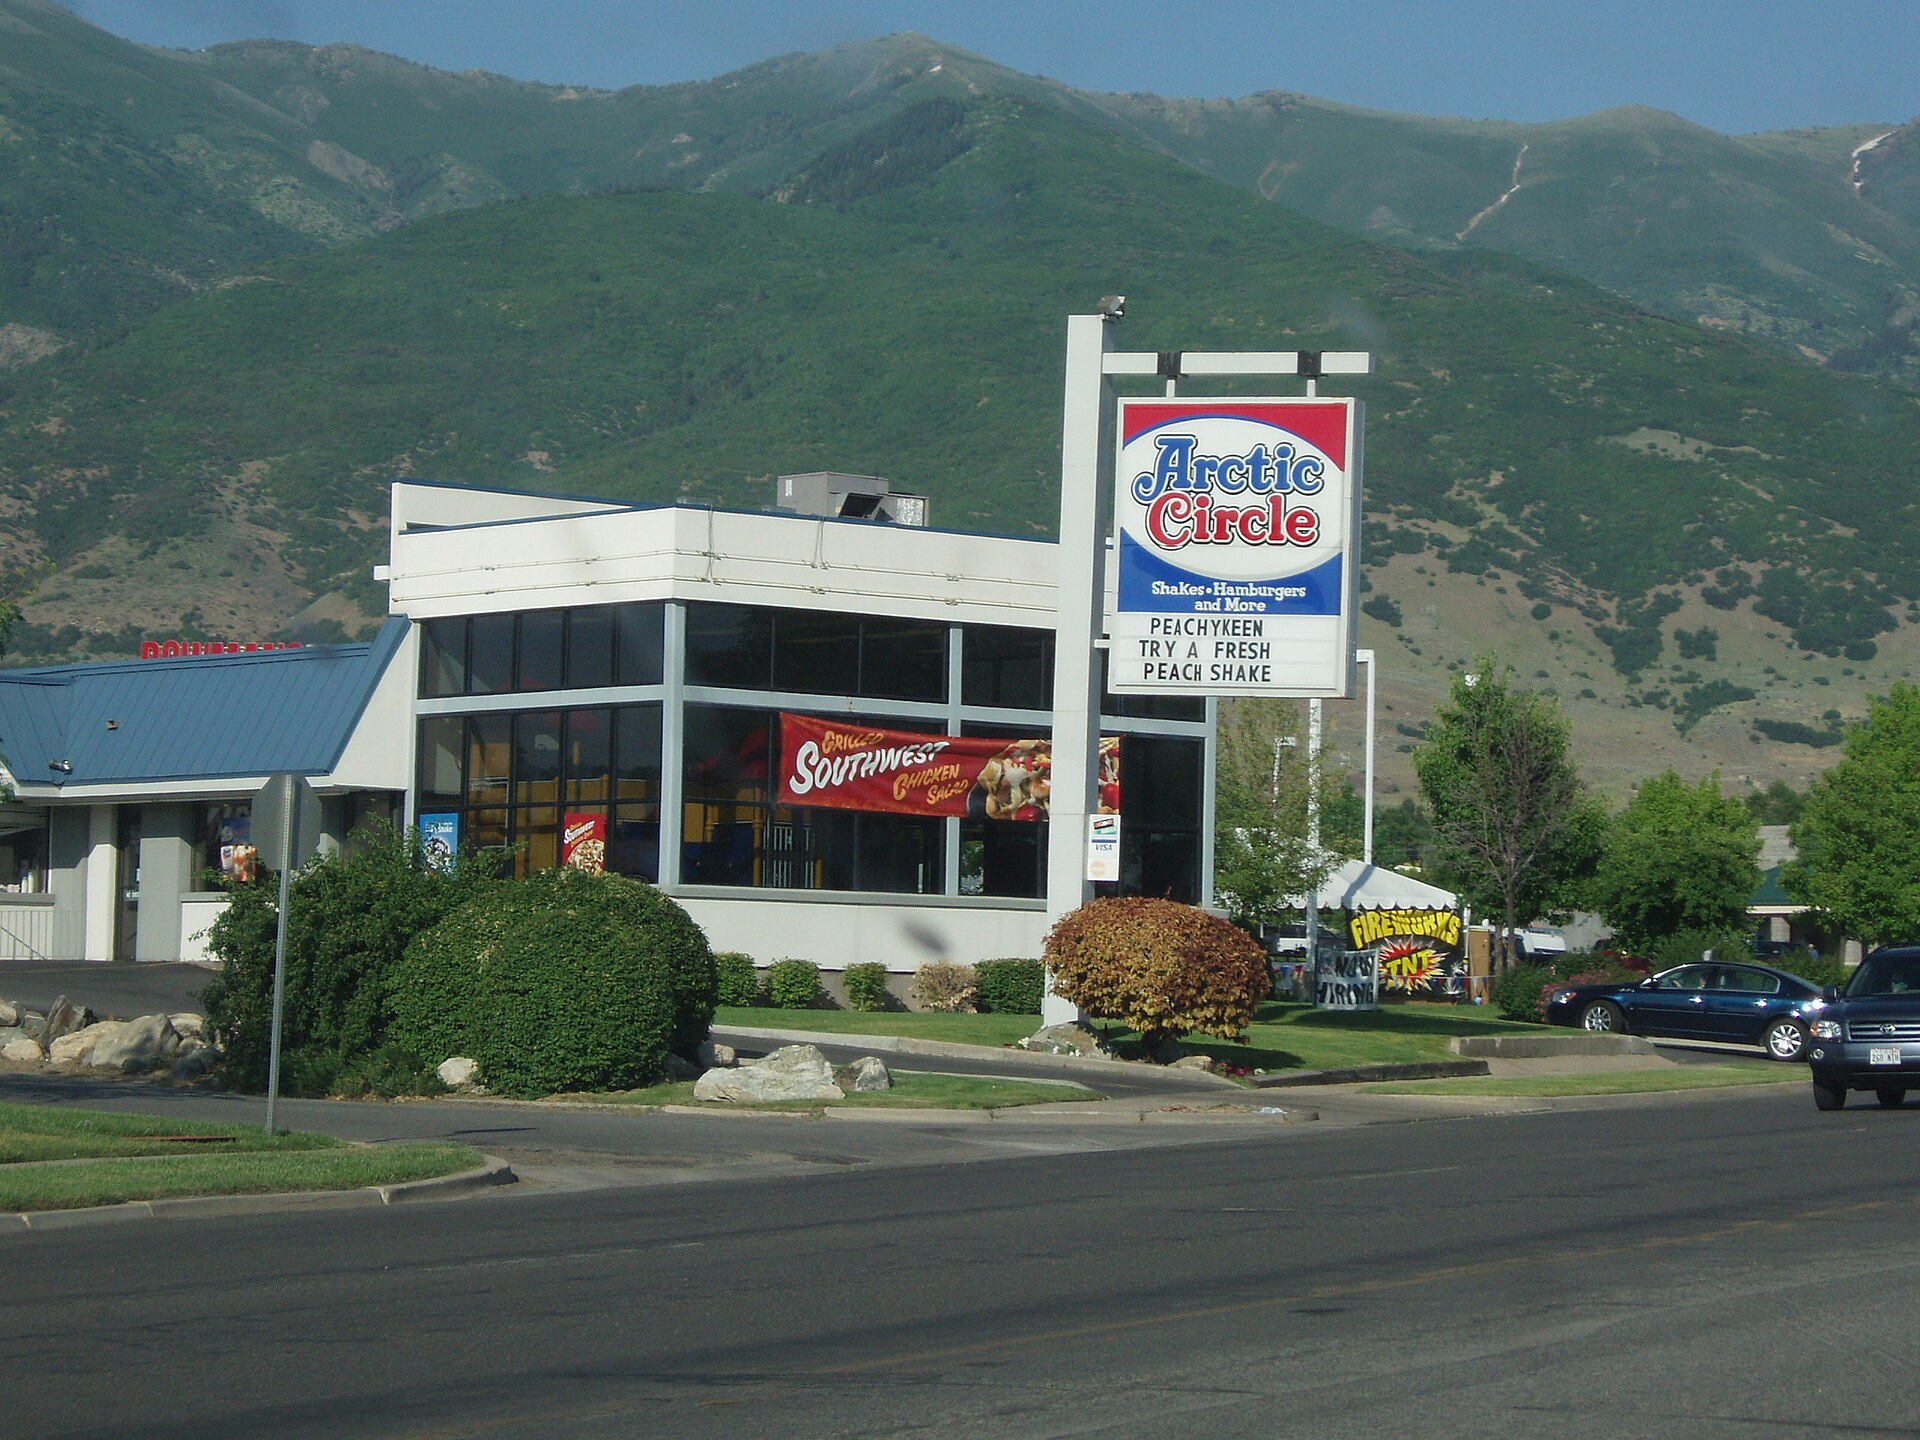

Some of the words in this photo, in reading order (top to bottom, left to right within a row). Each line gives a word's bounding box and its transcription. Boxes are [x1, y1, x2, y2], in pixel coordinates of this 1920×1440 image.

[1132, 434, 1324, 503] Arctic
[1146, 490, 1319, 549] Circle
[1212, 582, 1306, 601] Hamburgers
[1194, 598, 1221, 612] and
[1224, 598, 1266, 612] More
[1150, 617, 1263, 637] PEACHYKEEN
[1139, 640, 1177, 658] TRY
[1186, 641, 1199, 658] A
[1214, 641, 1271, 660] FRESH
[1143, 662, 1202, 681] PEACH
[1210, 663, 1272, 682] SHAKE
[821, 730, 885, 755] GRILLED
[788, 740, 951, 795] SOUTHWEST
[892, 763, 961, 801] CHICKEN
[926, 779, 969, 805] SALAD
[1095, 843, 1113, 851] VISA
[1386, 948, 1432, 978] TNT
